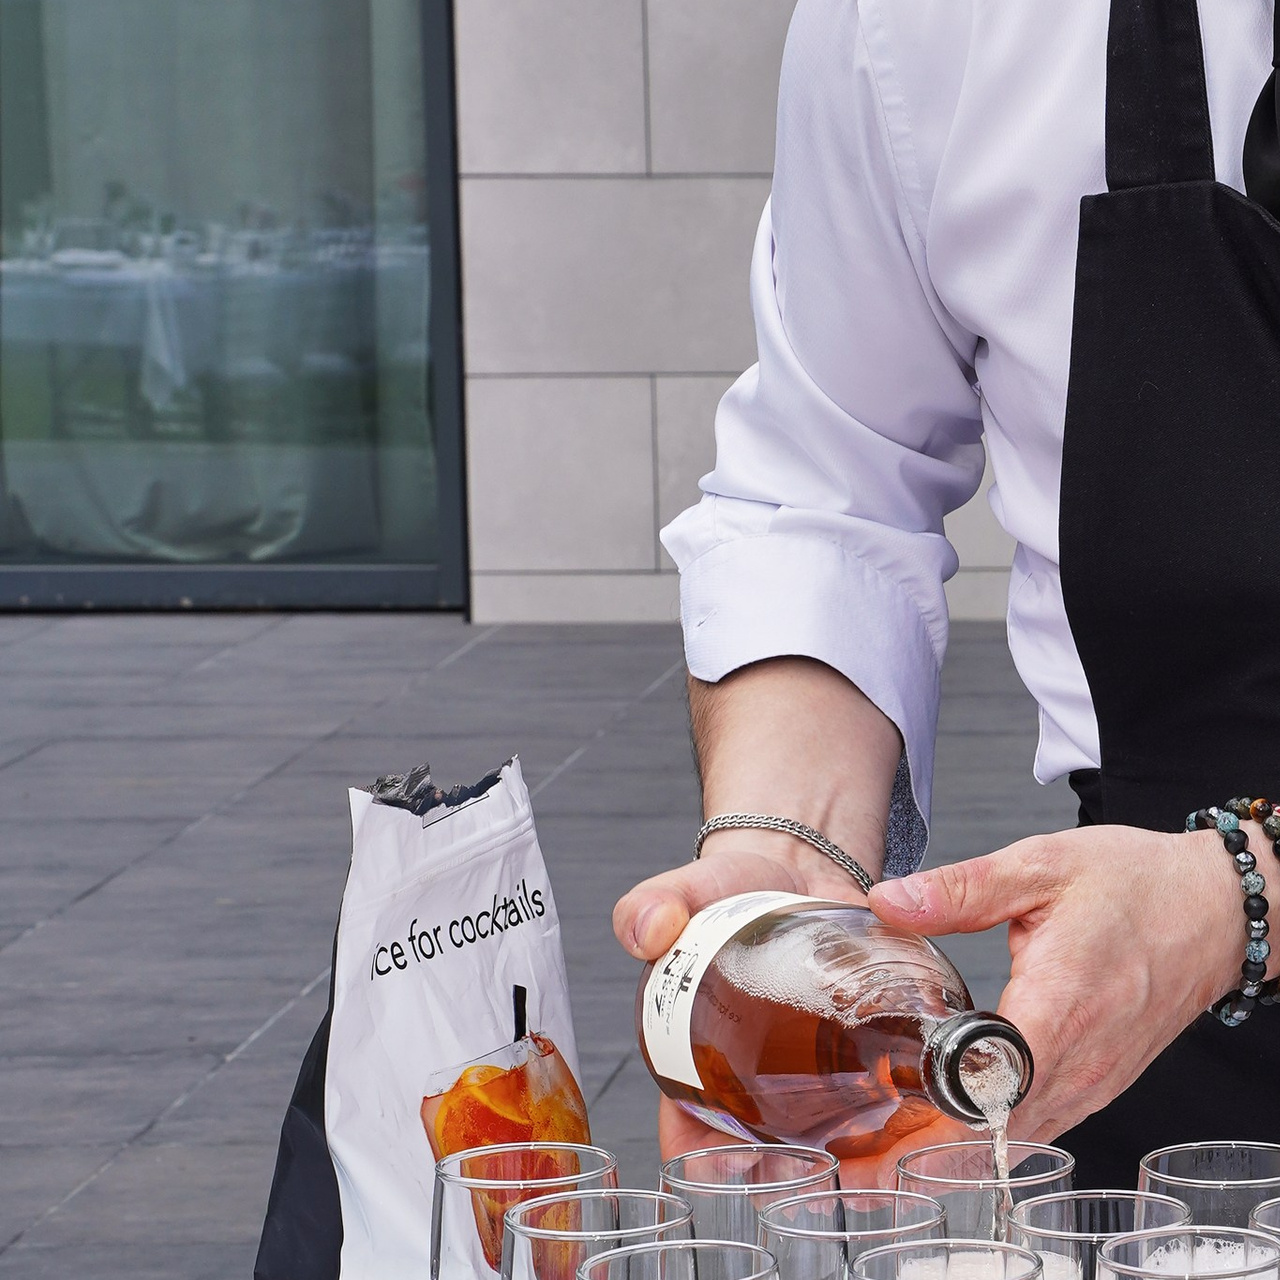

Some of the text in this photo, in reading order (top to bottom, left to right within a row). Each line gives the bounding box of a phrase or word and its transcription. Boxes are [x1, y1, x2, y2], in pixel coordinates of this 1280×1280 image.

[370, 878, 546, 981] ice for cocktails
